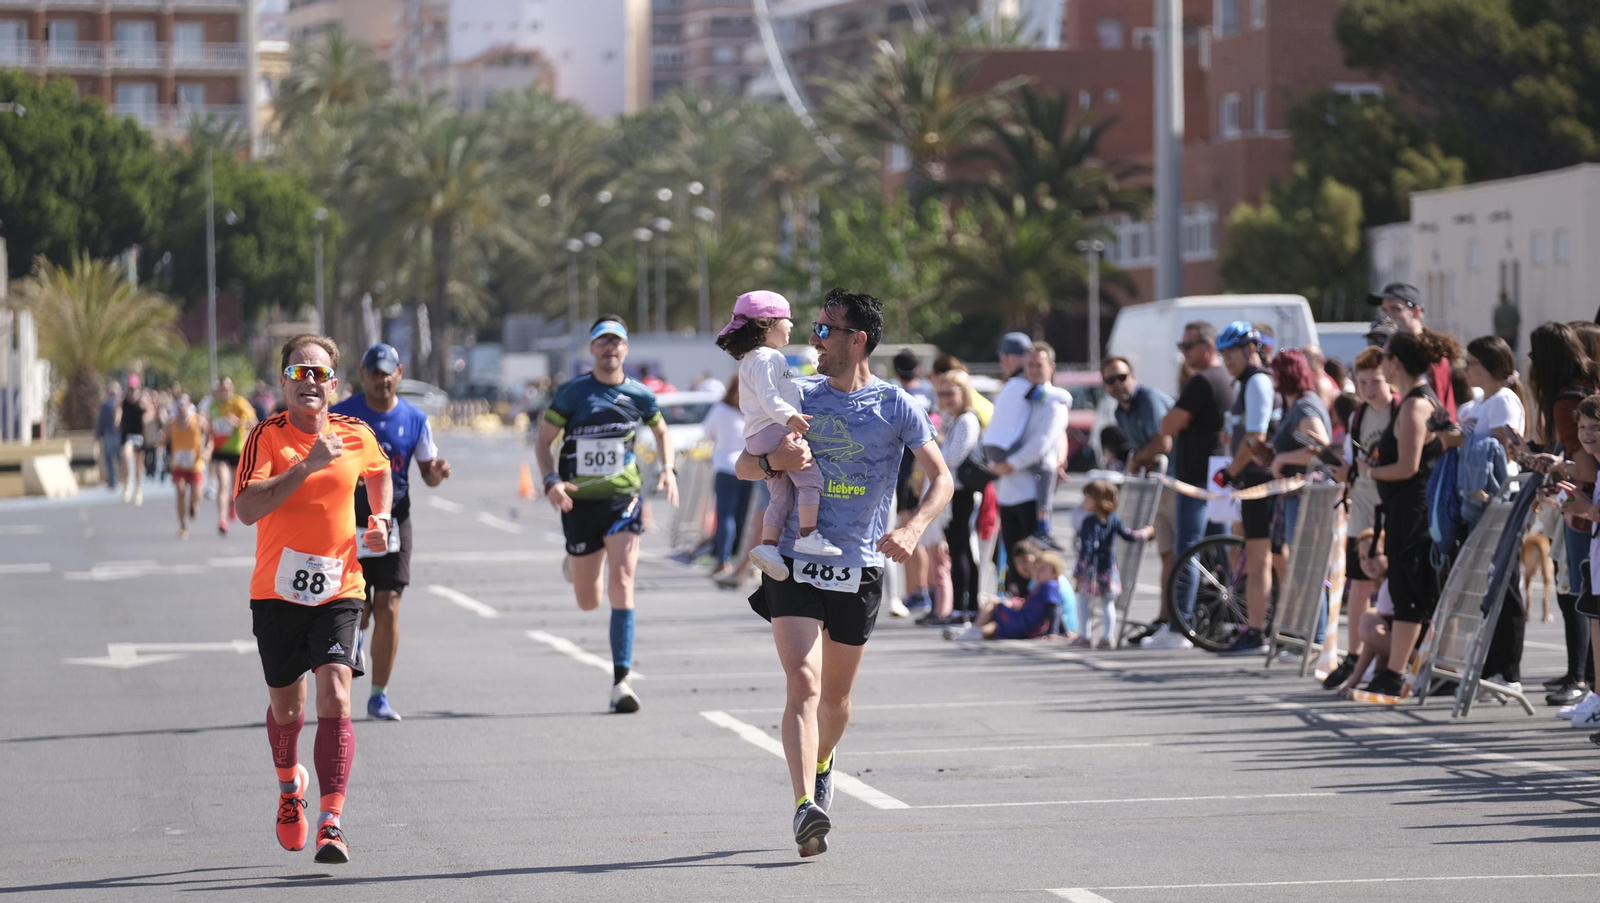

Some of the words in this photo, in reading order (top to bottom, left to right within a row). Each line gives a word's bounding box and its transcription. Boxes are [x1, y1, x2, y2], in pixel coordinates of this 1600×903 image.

[584, 451, 617, 467] 503
[828, 479, 866, 496] Liebres
[292, 569, 326, 595] 88
